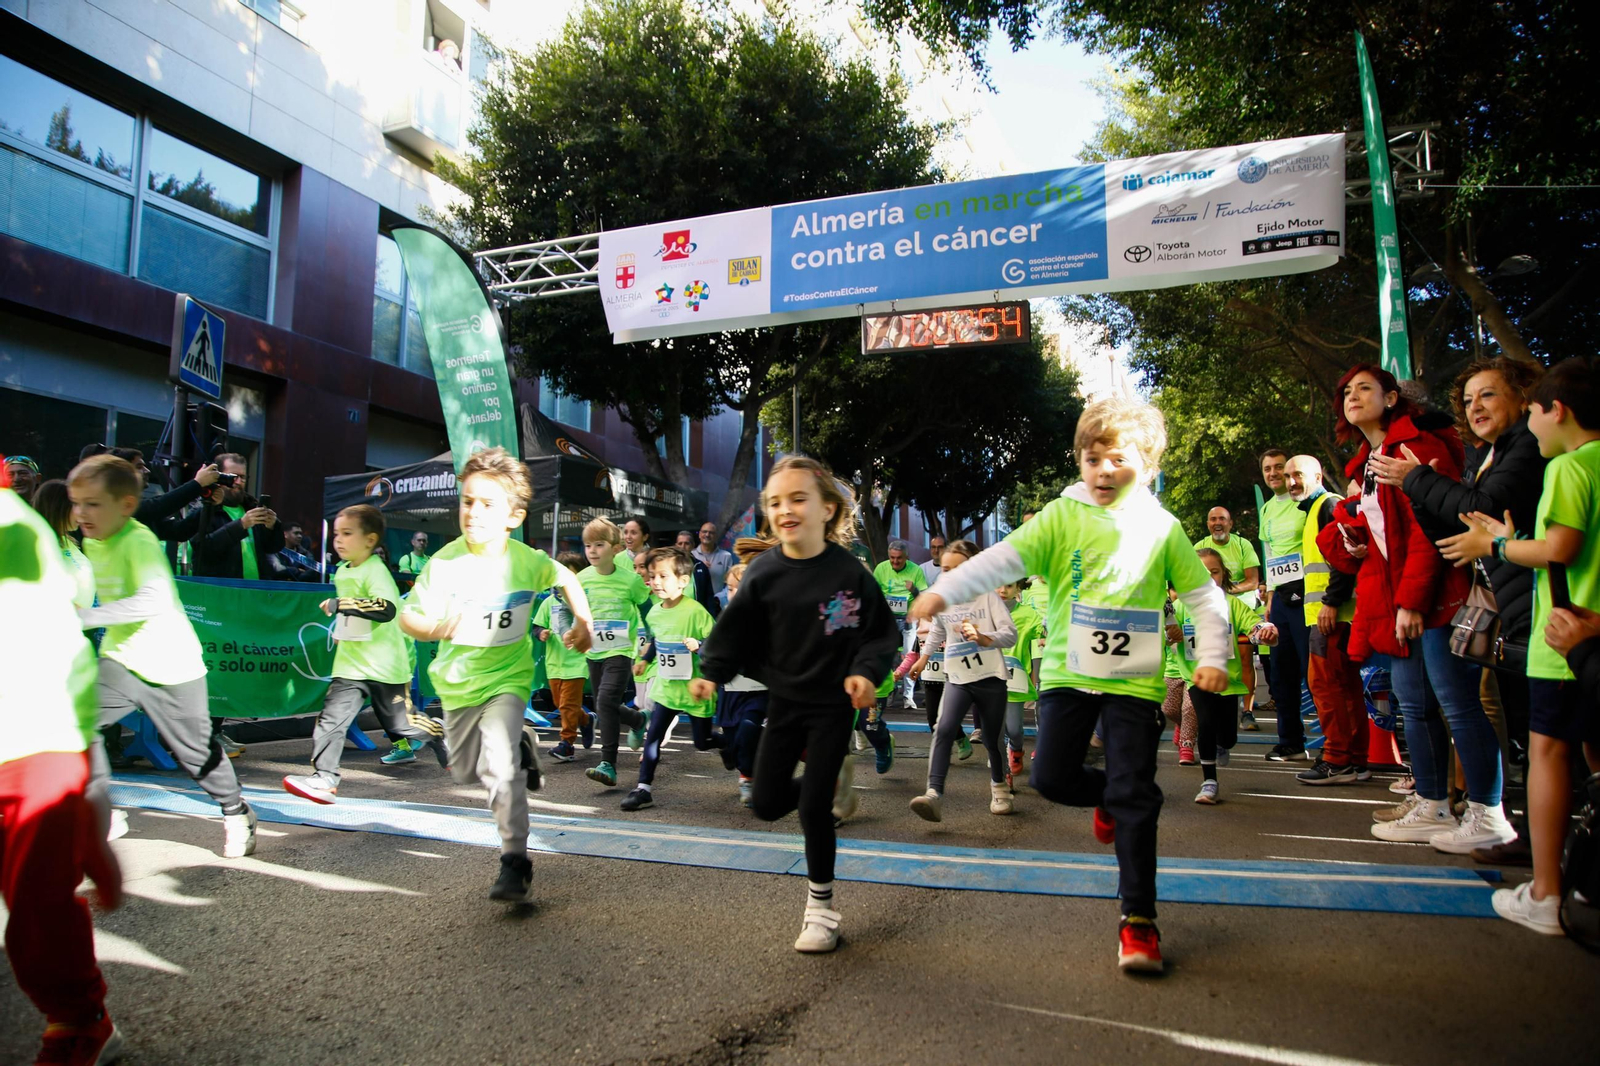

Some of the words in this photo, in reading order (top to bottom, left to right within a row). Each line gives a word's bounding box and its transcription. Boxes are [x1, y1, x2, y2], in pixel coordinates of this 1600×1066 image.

[1268, 154, 1330, 167] UNIVERSIDAD
[1269, 167, 1282, 175] DE
[1285, 161, 1330, 173] ALMERÍA
[1148, 168, 1216, 187] cajamar
[791, 202, 904, 239] Almería
[915, 199, 950, 221] en
[963, 181, 1083, 215] marcha
[1151, 215, 1198, 225] MICHELIN
[1215, 198, 1295, 219] Fundación
[1257, 221, 1285, 235] Ejido
[1287, 218, 1324, 229] Motor
[791, 240, 885, 270] contra
[894, 231, 923, 257] el
[932, 223, 1043, 251] cáncer
[1157, 242, 1190, 251] Toyota
[1275, 240, 1293, 248] Jeep
[1296, 236, 1309, 247] FIAT
[1029, 255, 1066, 265] asociación
[1067, 252, 1098, 262] española
[1157, 250, 1196, 261] Alborán
[1198, 248, 1227, 259] Motor
[731, 258, 758, 272] SOLAN
[1030, 264, 1052, 272] contra
[1060, 261, 1084, 269] cáncer
[1041, 270, 1069, 279] Almería
[605, 291, 643, 305] ALMERÍA
[783, 284, 879, 303] #TodosContraElCáncer
[395, 471, 456, 494] cruzando
[1270, 562, 1300, 577] 1043
[483, 610, 513, 630] 18
[596, 630, 615, 643] 16
[1091, 631, 1131, 657] 32
[222, 640, 239, 655] el
[242, 642, 296, 657] cáncer
[219, 657, 256, 673] solo
[259, 660, 289, 674] uno
[659, 653, 676, 668] 95
[961, 653, 984, 670] 11
